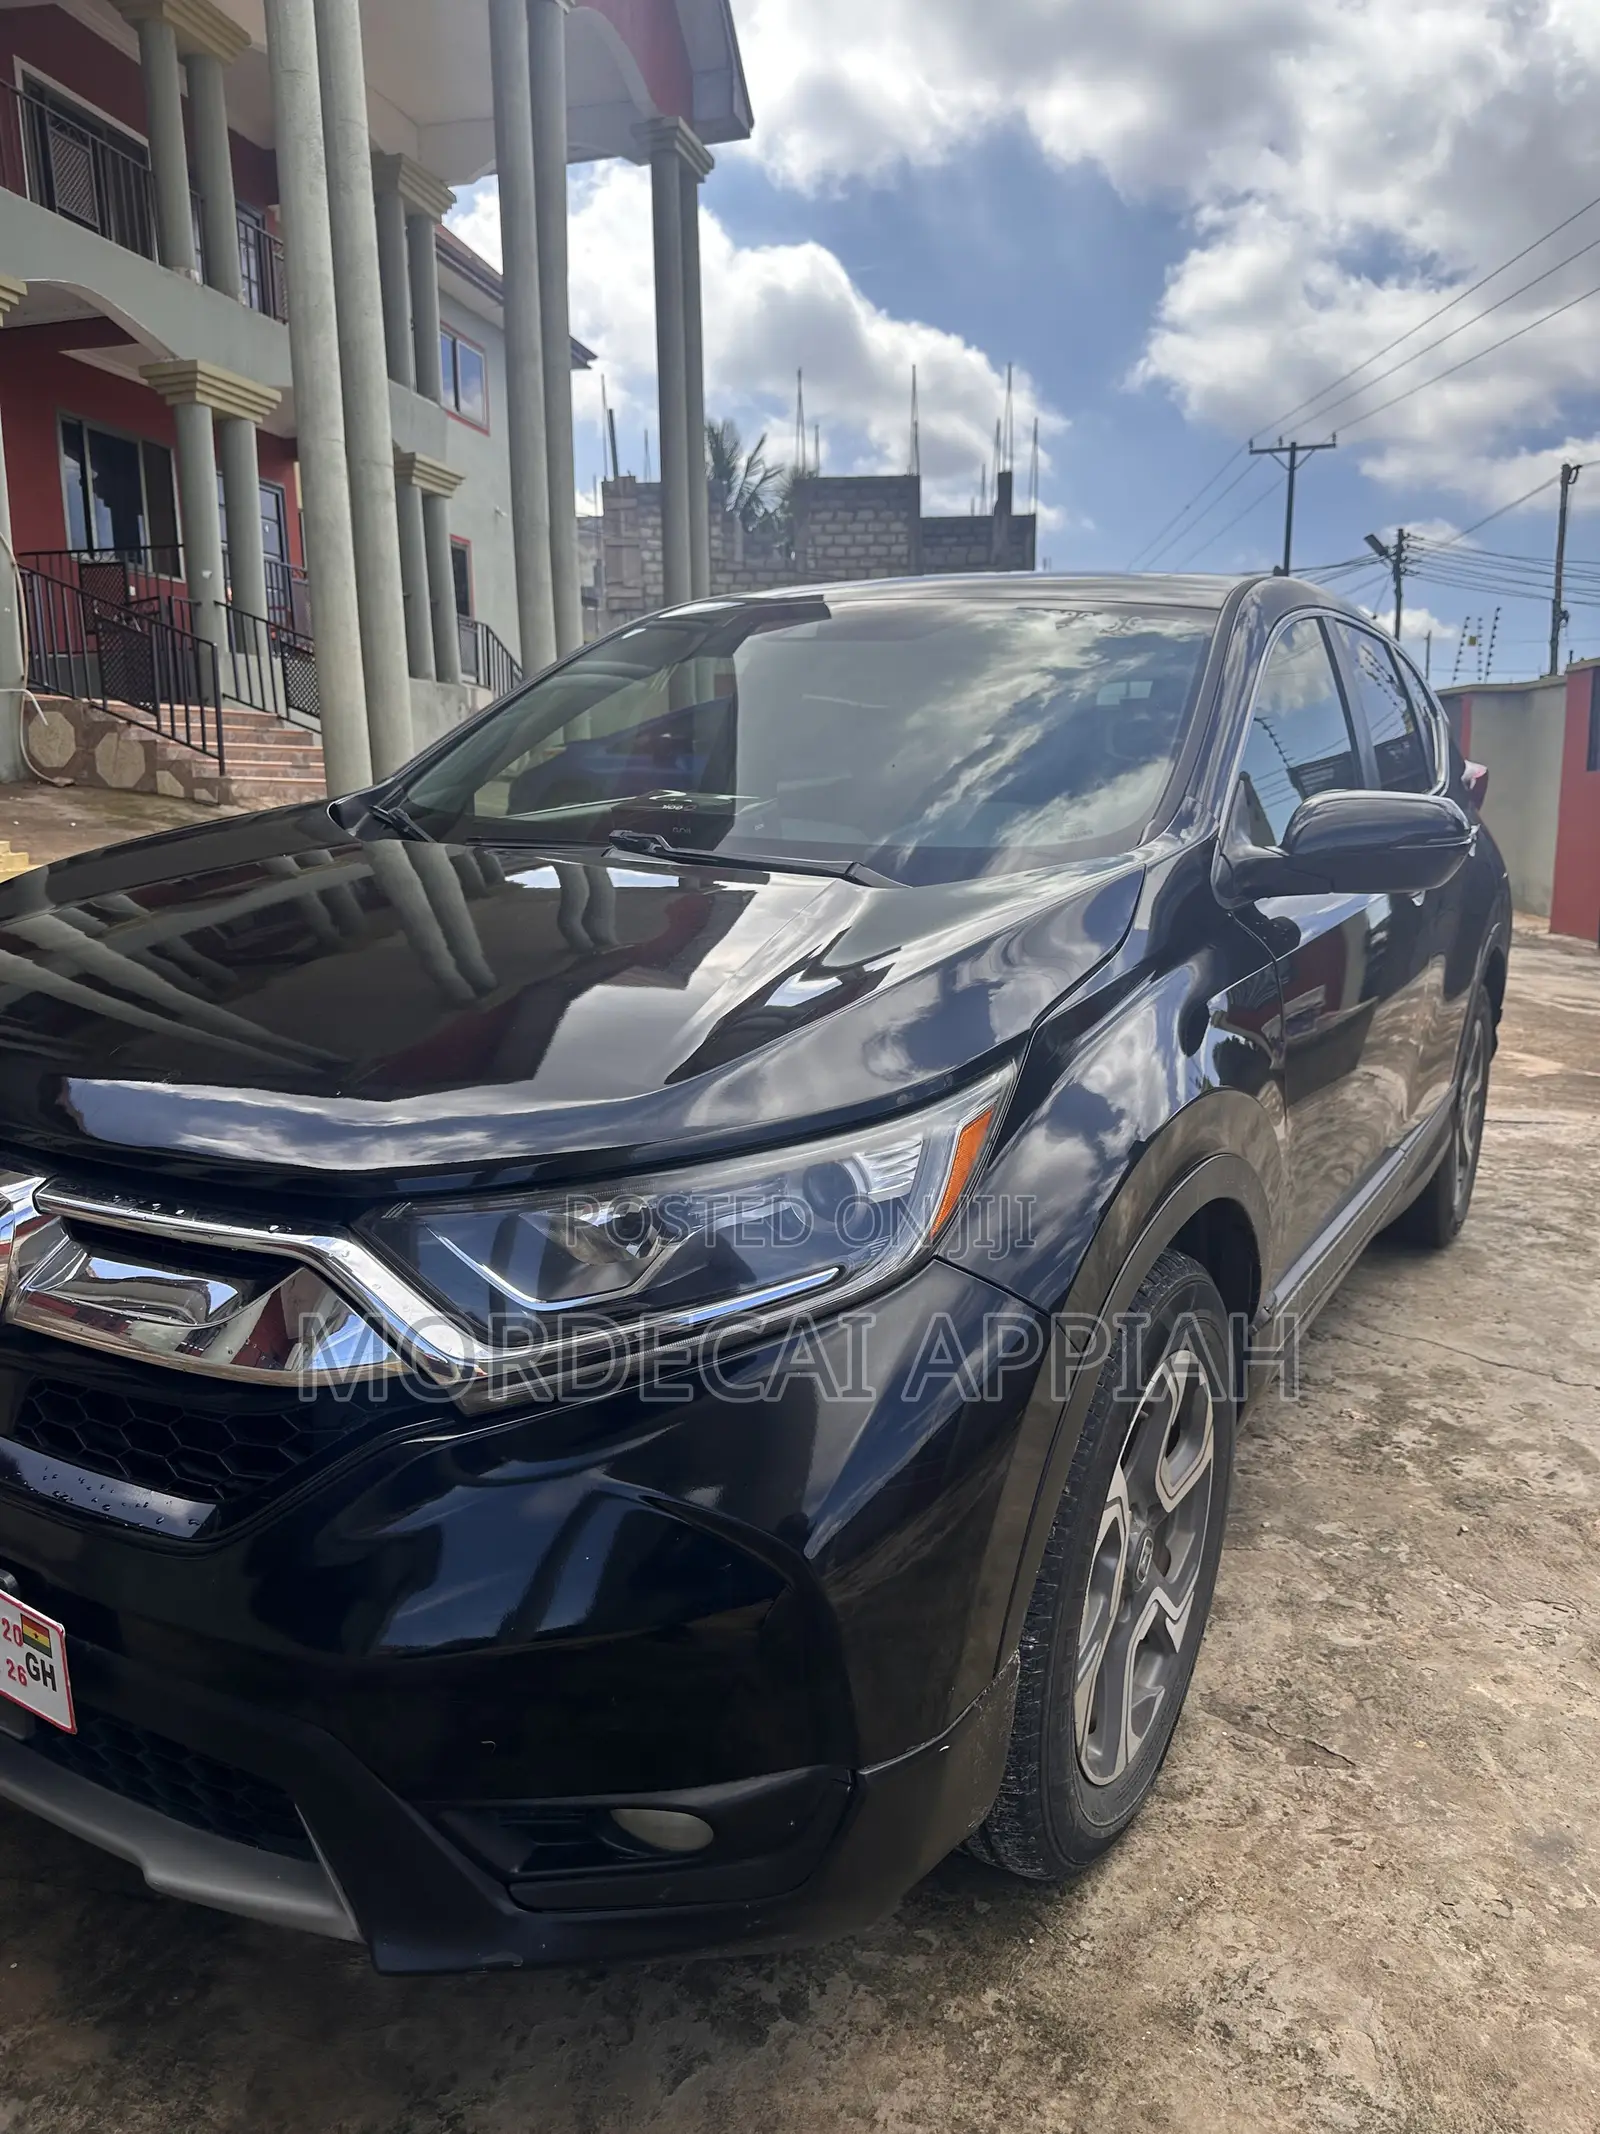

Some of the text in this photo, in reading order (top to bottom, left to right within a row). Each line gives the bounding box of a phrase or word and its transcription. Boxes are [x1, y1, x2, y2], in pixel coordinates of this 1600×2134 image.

[1, 1617, 24, 1648] 20
[6, 1658, 28, 1687] 26
[26, 1652, 57, 1692] GH
